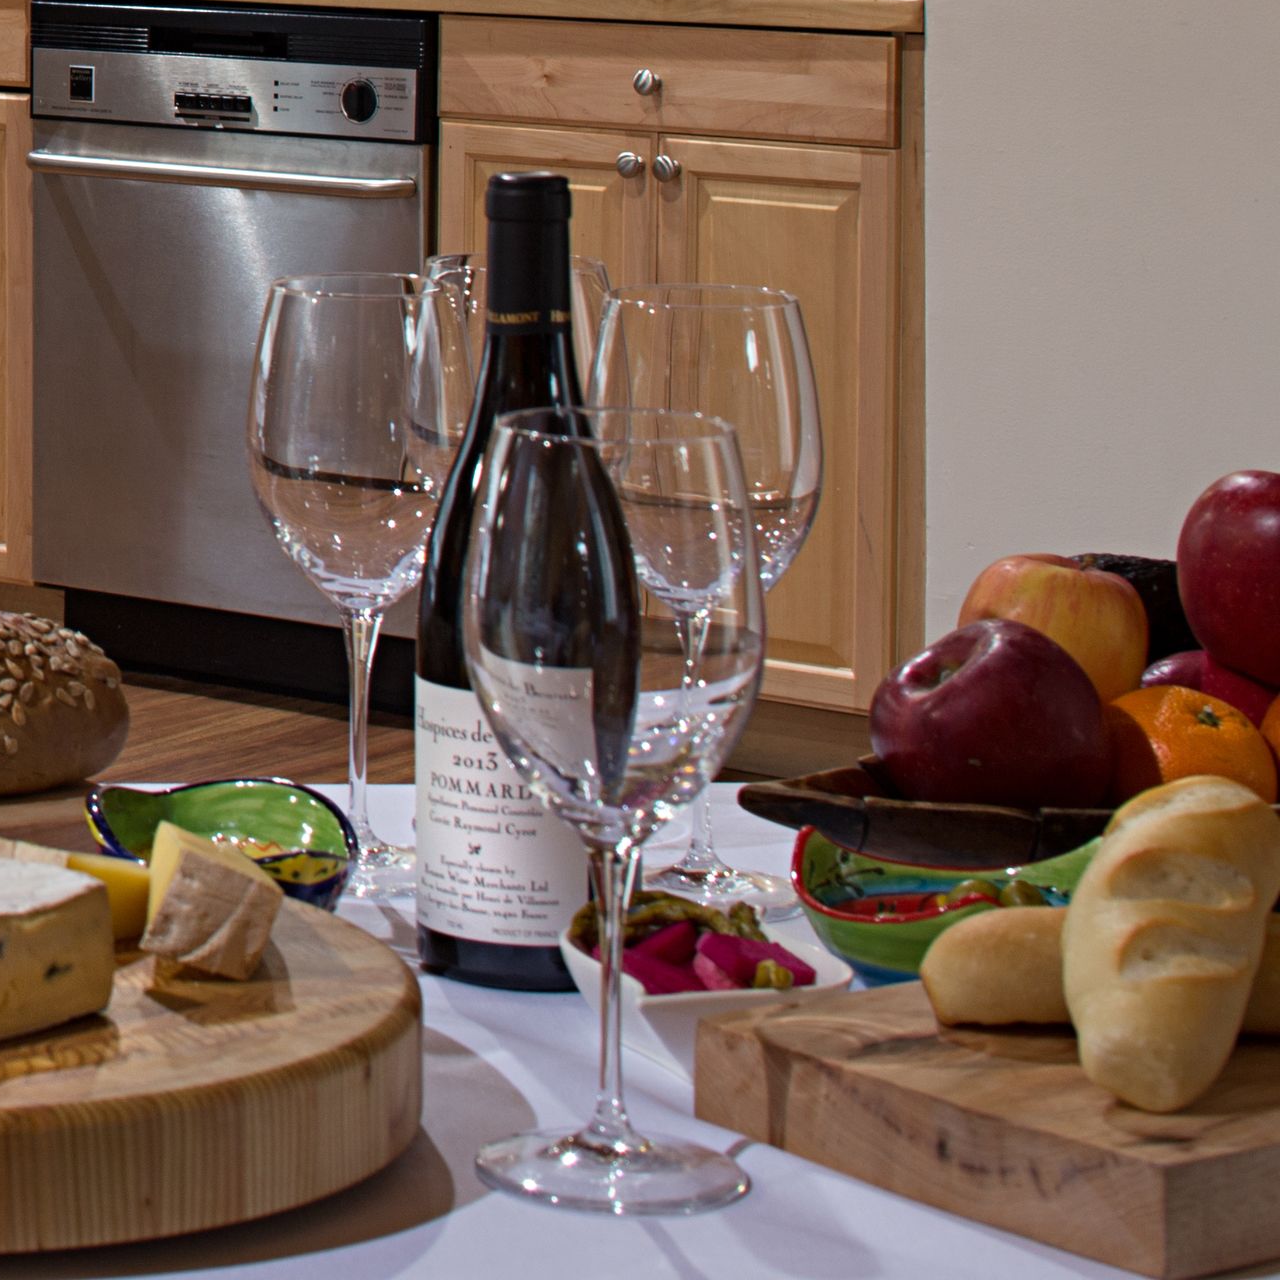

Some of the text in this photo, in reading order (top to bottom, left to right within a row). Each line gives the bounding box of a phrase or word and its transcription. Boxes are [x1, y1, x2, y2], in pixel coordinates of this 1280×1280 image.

[416, 706, 493, 743] Hospices de
[452, 751, 499, 771] 2013
[430, 771, 533, 801] POMMARD
[531, 881, 549, 892] Ltd
